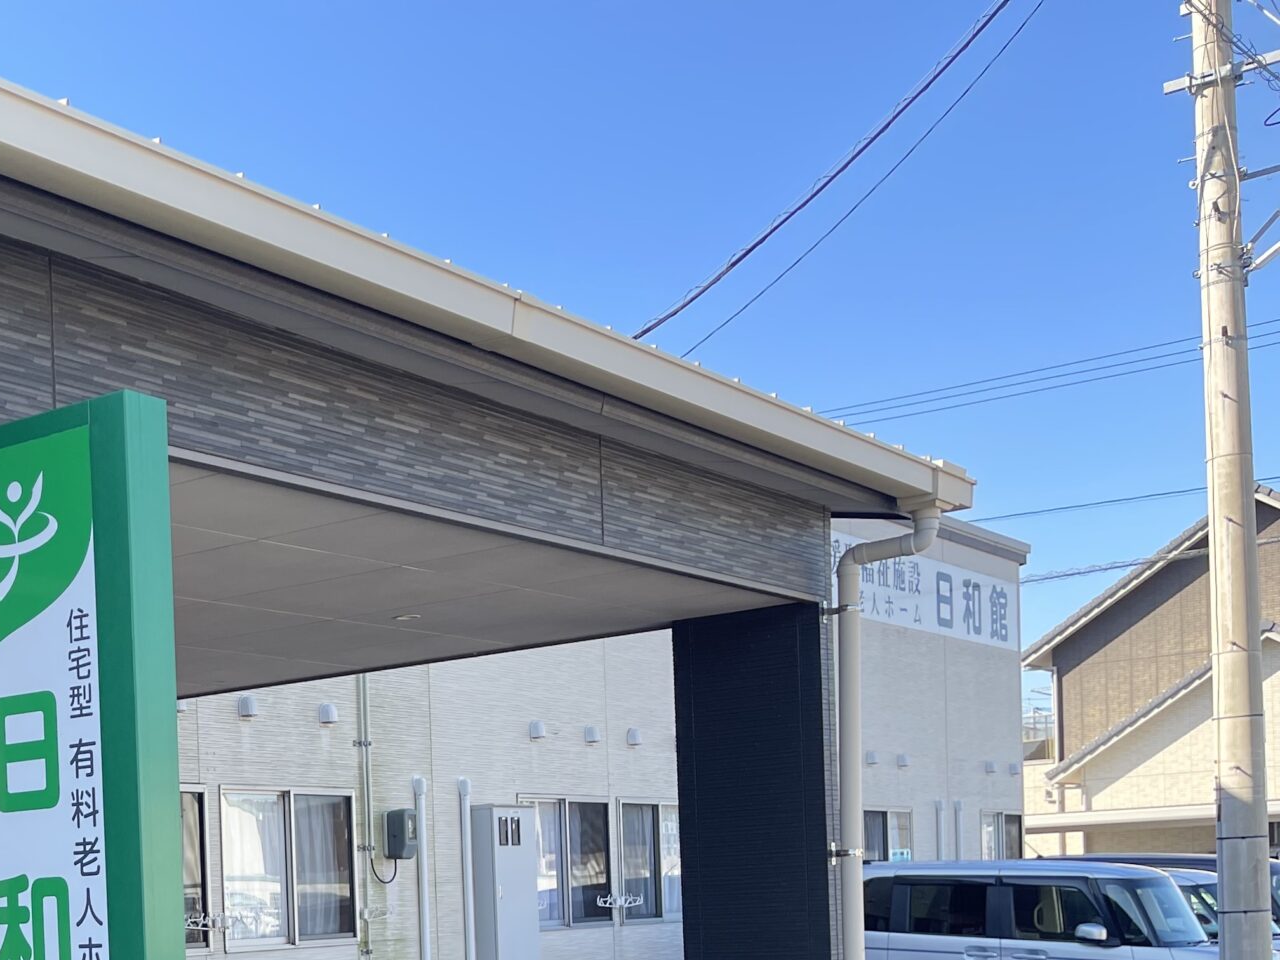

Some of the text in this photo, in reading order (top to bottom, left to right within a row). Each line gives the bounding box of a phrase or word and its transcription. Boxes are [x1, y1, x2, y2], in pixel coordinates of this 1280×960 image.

[936, 571, 1008, 642] 日和館
[66, 607, 93, 719] 住宅型
